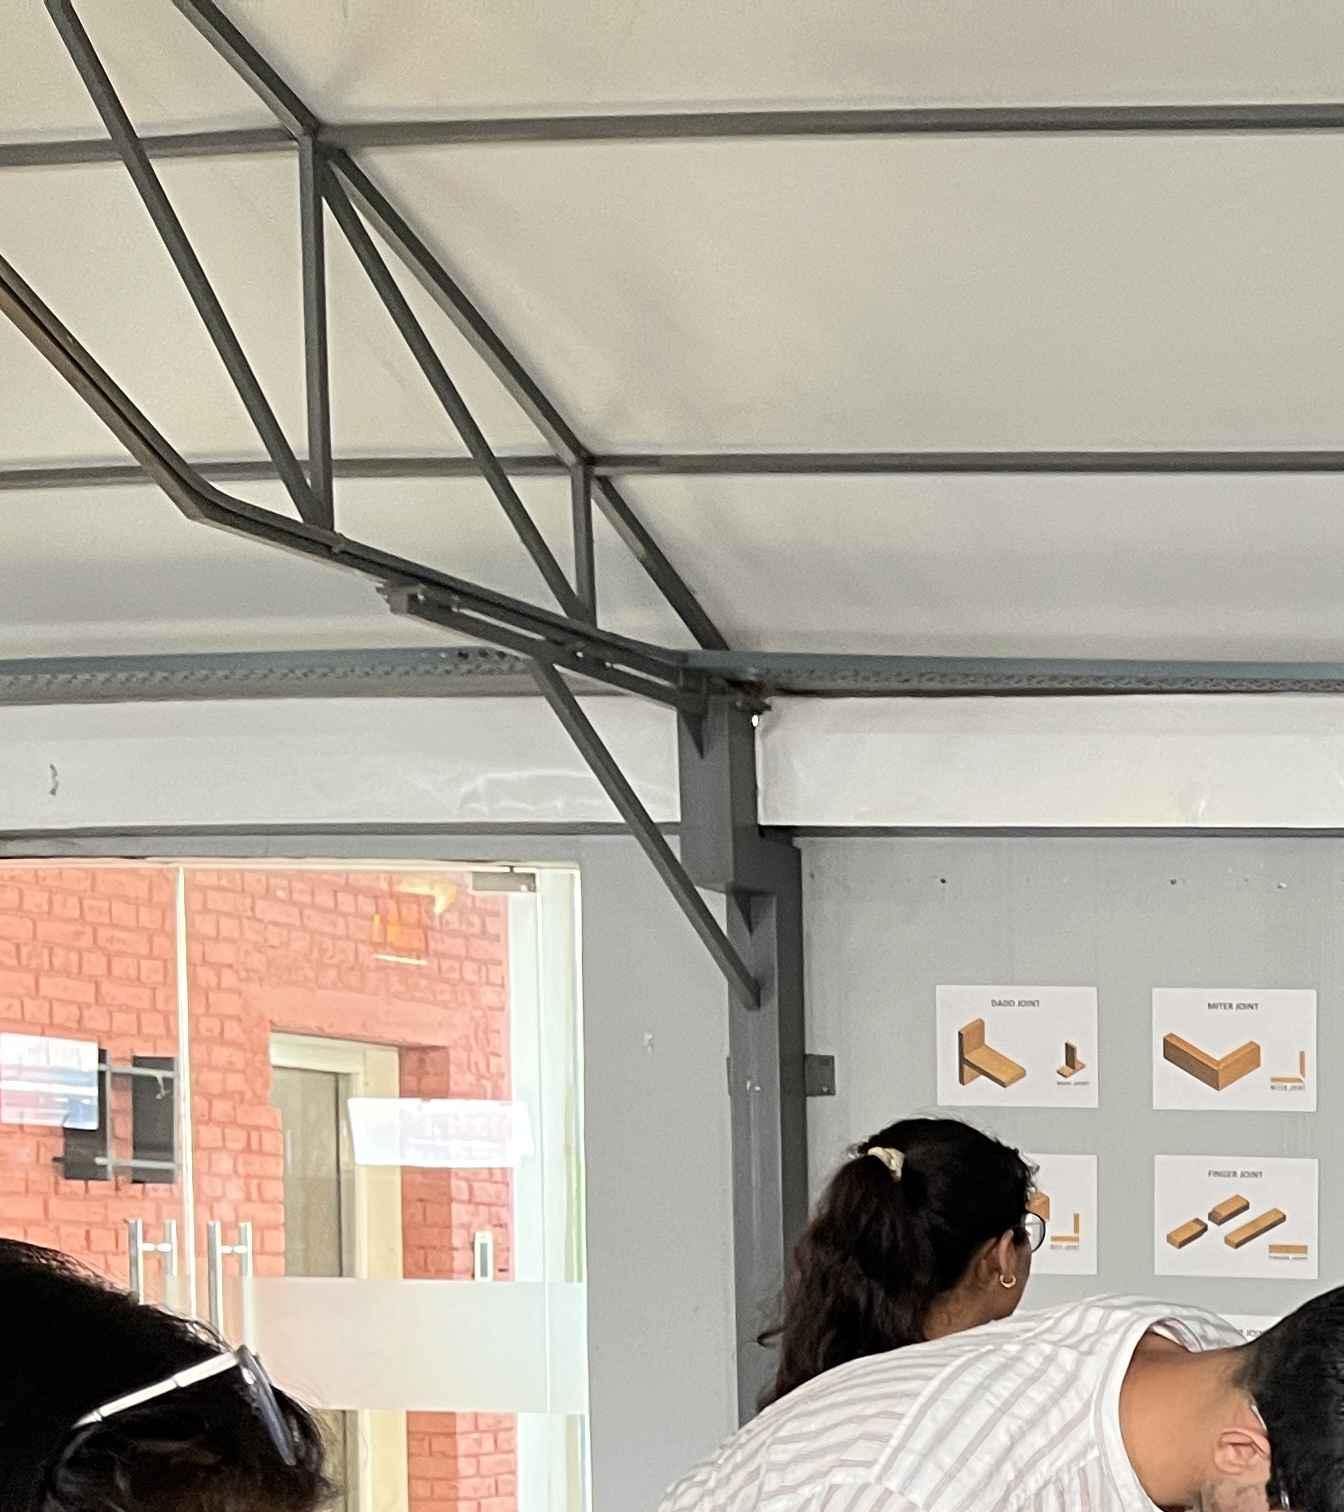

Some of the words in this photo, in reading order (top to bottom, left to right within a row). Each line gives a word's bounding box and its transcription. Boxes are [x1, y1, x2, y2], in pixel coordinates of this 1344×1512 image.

[1017, 999, 1040, 1008] JOINT
[1207, 1002, 1234, 1010] MITER
[1235, 1002, 1259, 1011] JOINT
[1207, 1170, 1237, 1178] FINGER
[1239, 1170, 1263, 1179] JOINT
